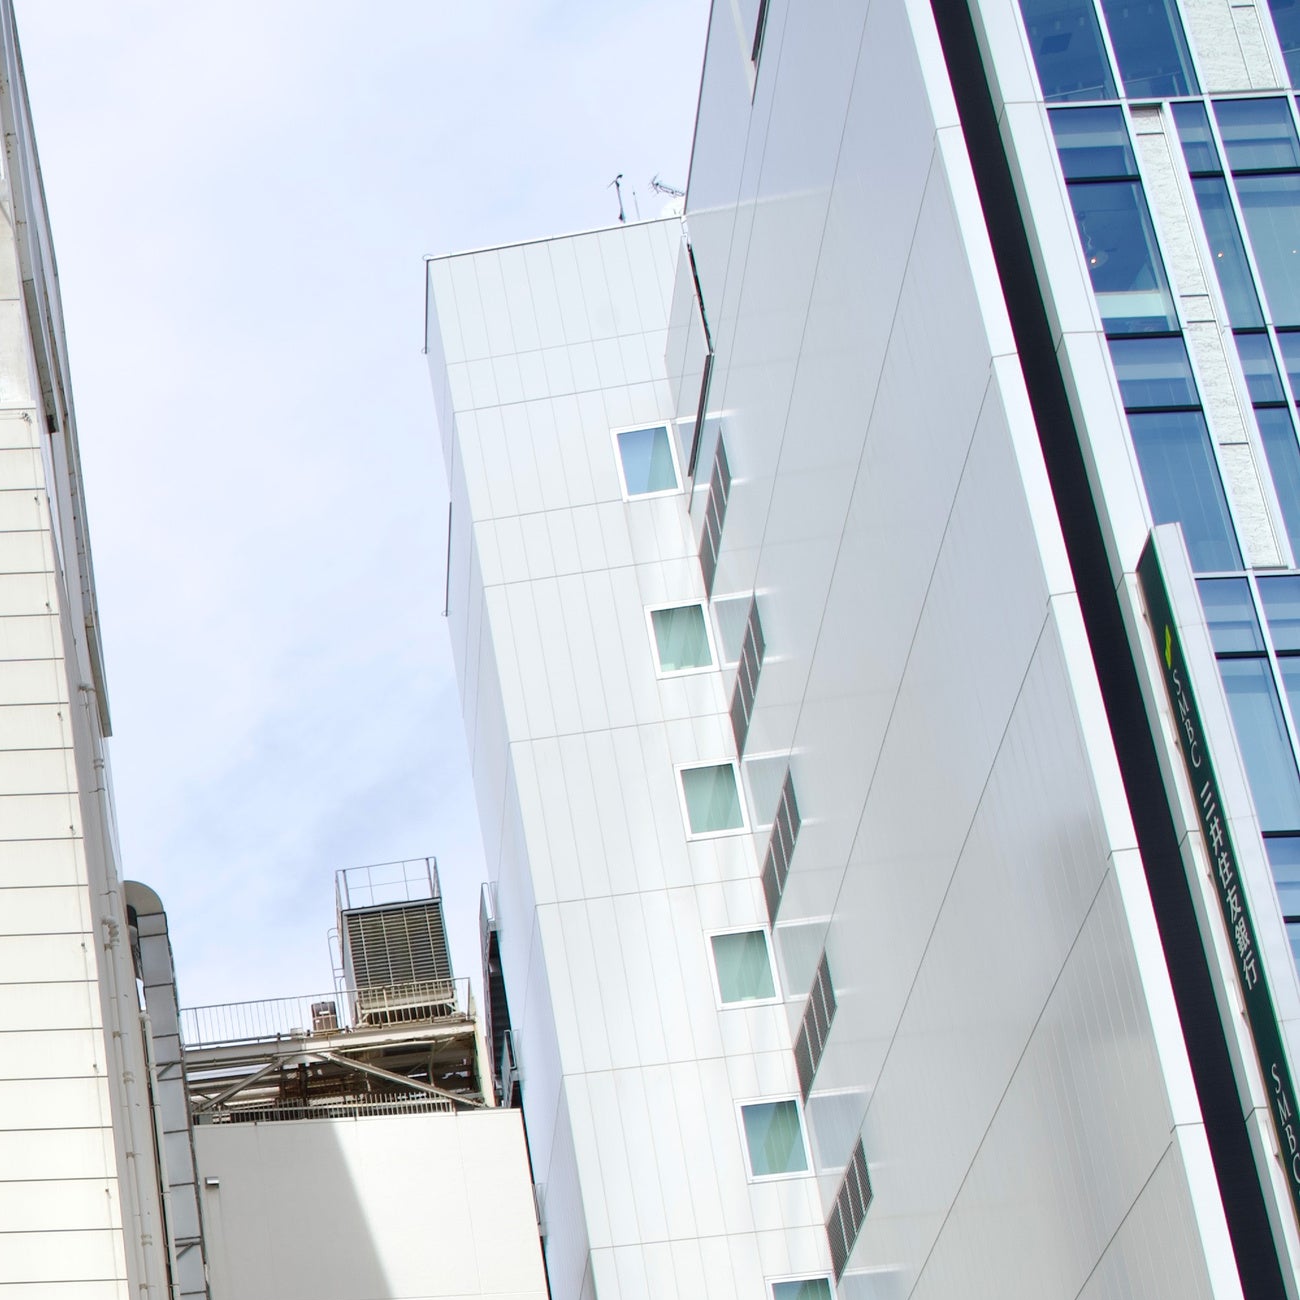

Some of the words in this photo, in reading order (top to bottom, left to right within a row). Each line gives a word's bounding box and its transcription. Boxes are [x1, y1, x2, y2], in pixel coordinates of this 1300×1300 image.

[1173, 668, 1201, 768] SMBC
[1200, 782, 1257, 990] 三井住友銀行
